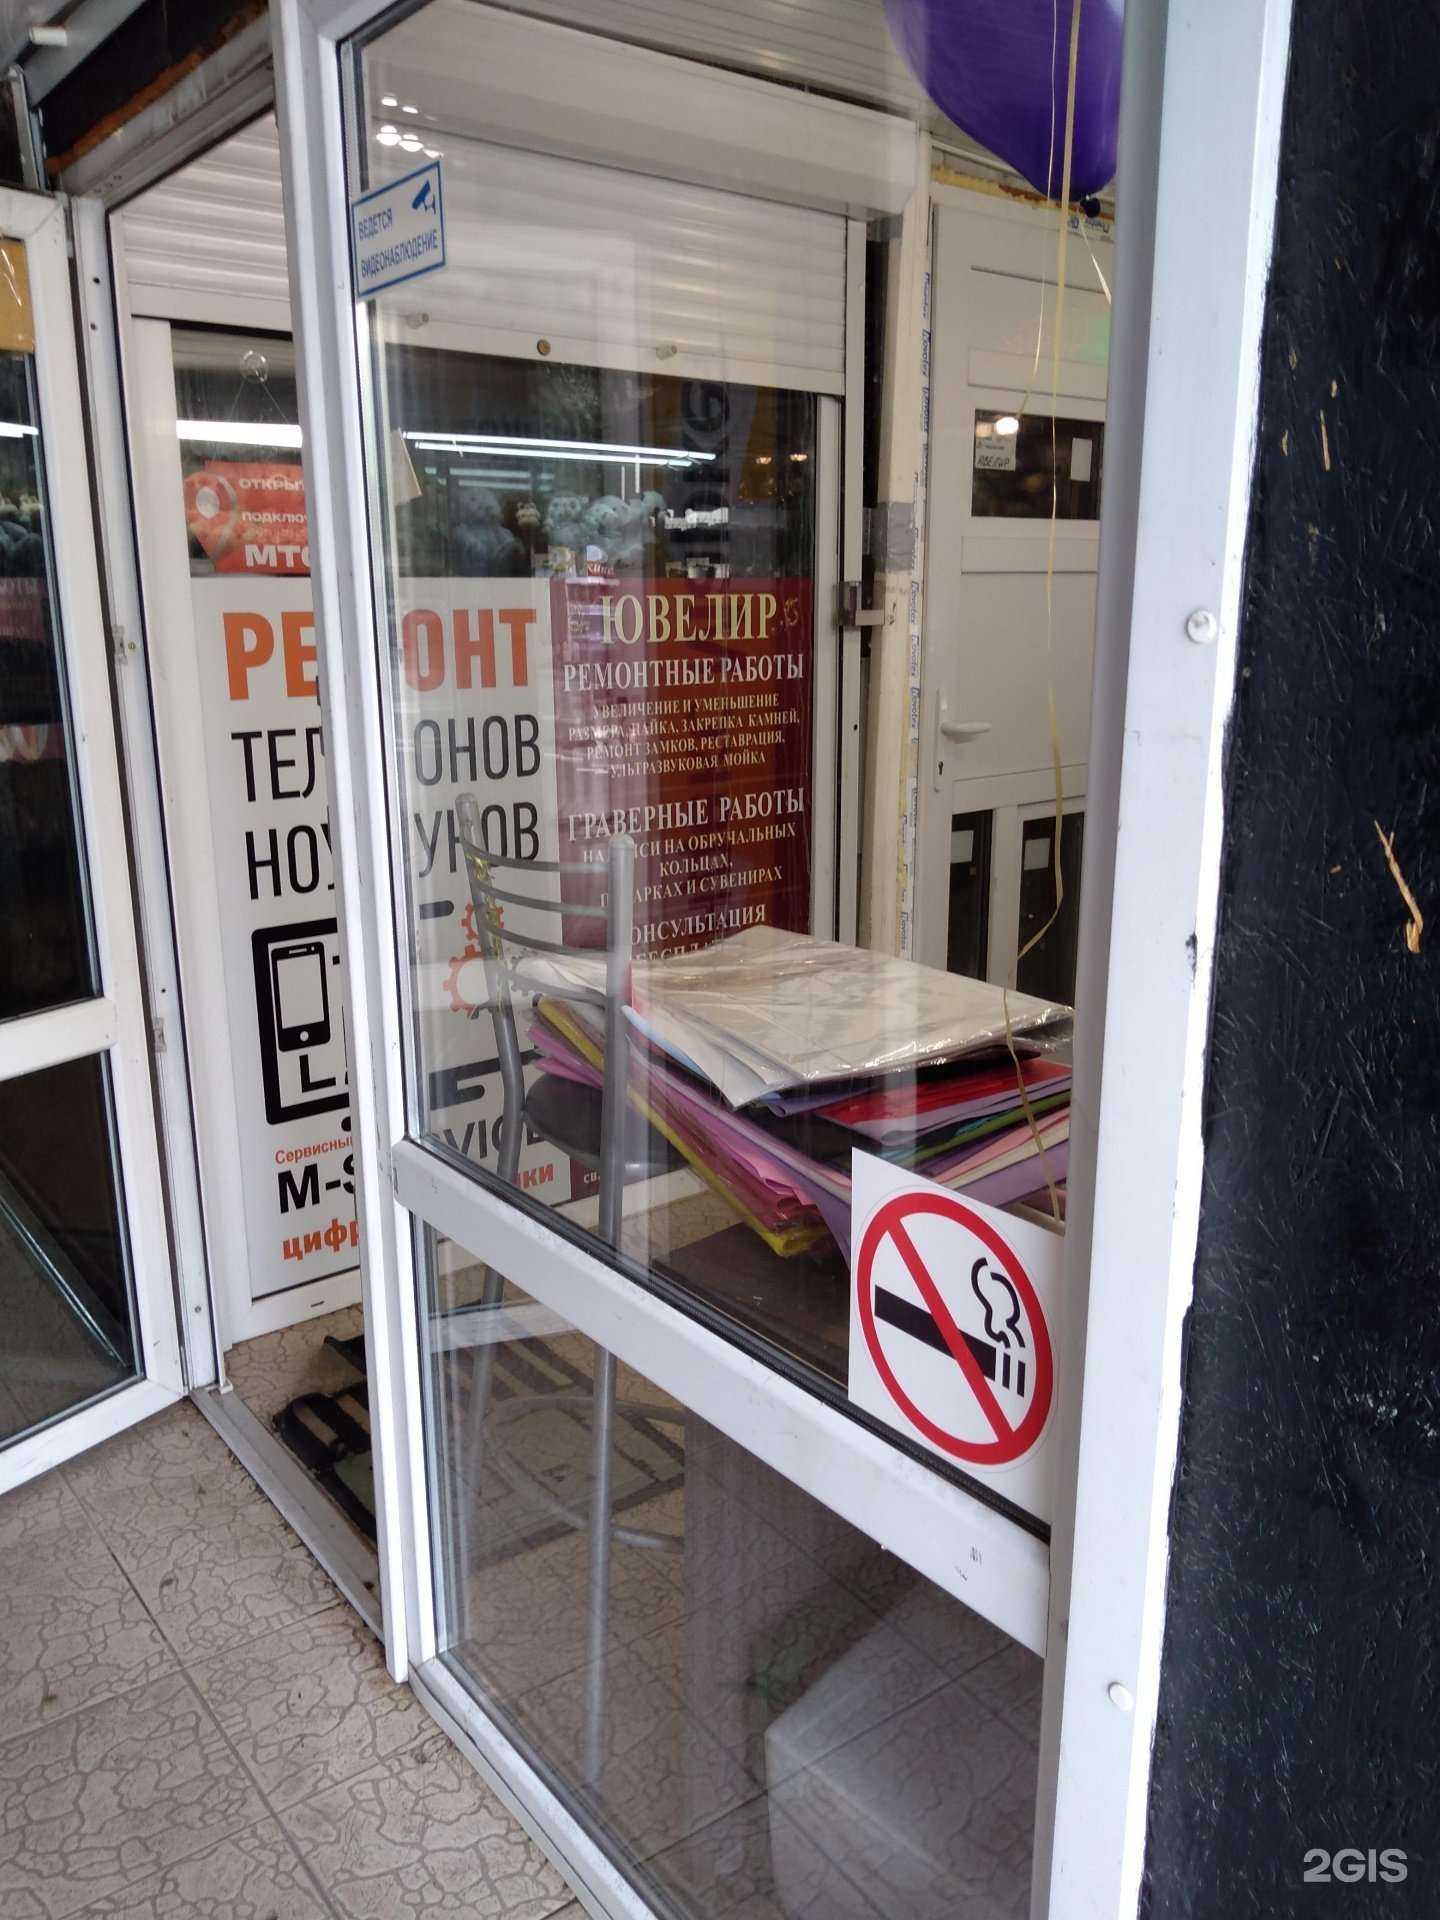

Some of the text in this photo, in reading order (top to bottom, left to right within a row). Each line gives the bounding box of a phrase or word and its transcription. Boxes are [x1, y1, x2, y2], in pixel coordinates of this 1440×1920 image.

[358, 208, 393, 241] ВЕДЕТСЯ
[361, 228, 439, 278] ВИДЕОНАБЛЮДЕНИЕ
[600, 593, 777, 644] ЮВЕЛИР
[223, 608, 537, 701] РЕОНТ
[563, 653, 804, 692] РЕМОНТНЫЕ РАБОТЫ
[593, 693, 779, 720] УВЕЛИЧЕНИЕ И УМЕНЬШЕНИЕ
[681, 714, 744, 734] ЗАКРЕПКА
[231, 714, 541, 802] ТЕЛОНОВ
[610, 749, 766, 779] УЛЬТРАЗВУКОВАЯ МОЙКА
[568, 787, 805, 842] ГРАВЕРНЫЕ РАБОТЫ
[245, 801, 541, 901] НОУОВ
[583, 822, 796, 864] НАСИ НА ОБРУЧАЛЬНЫХ
[600, 865, 783, 908] ПАРКАХ И СУВЕНИРАХ
[631, 903, 766, 946] ОНСУЛЬТАЦИЯ
